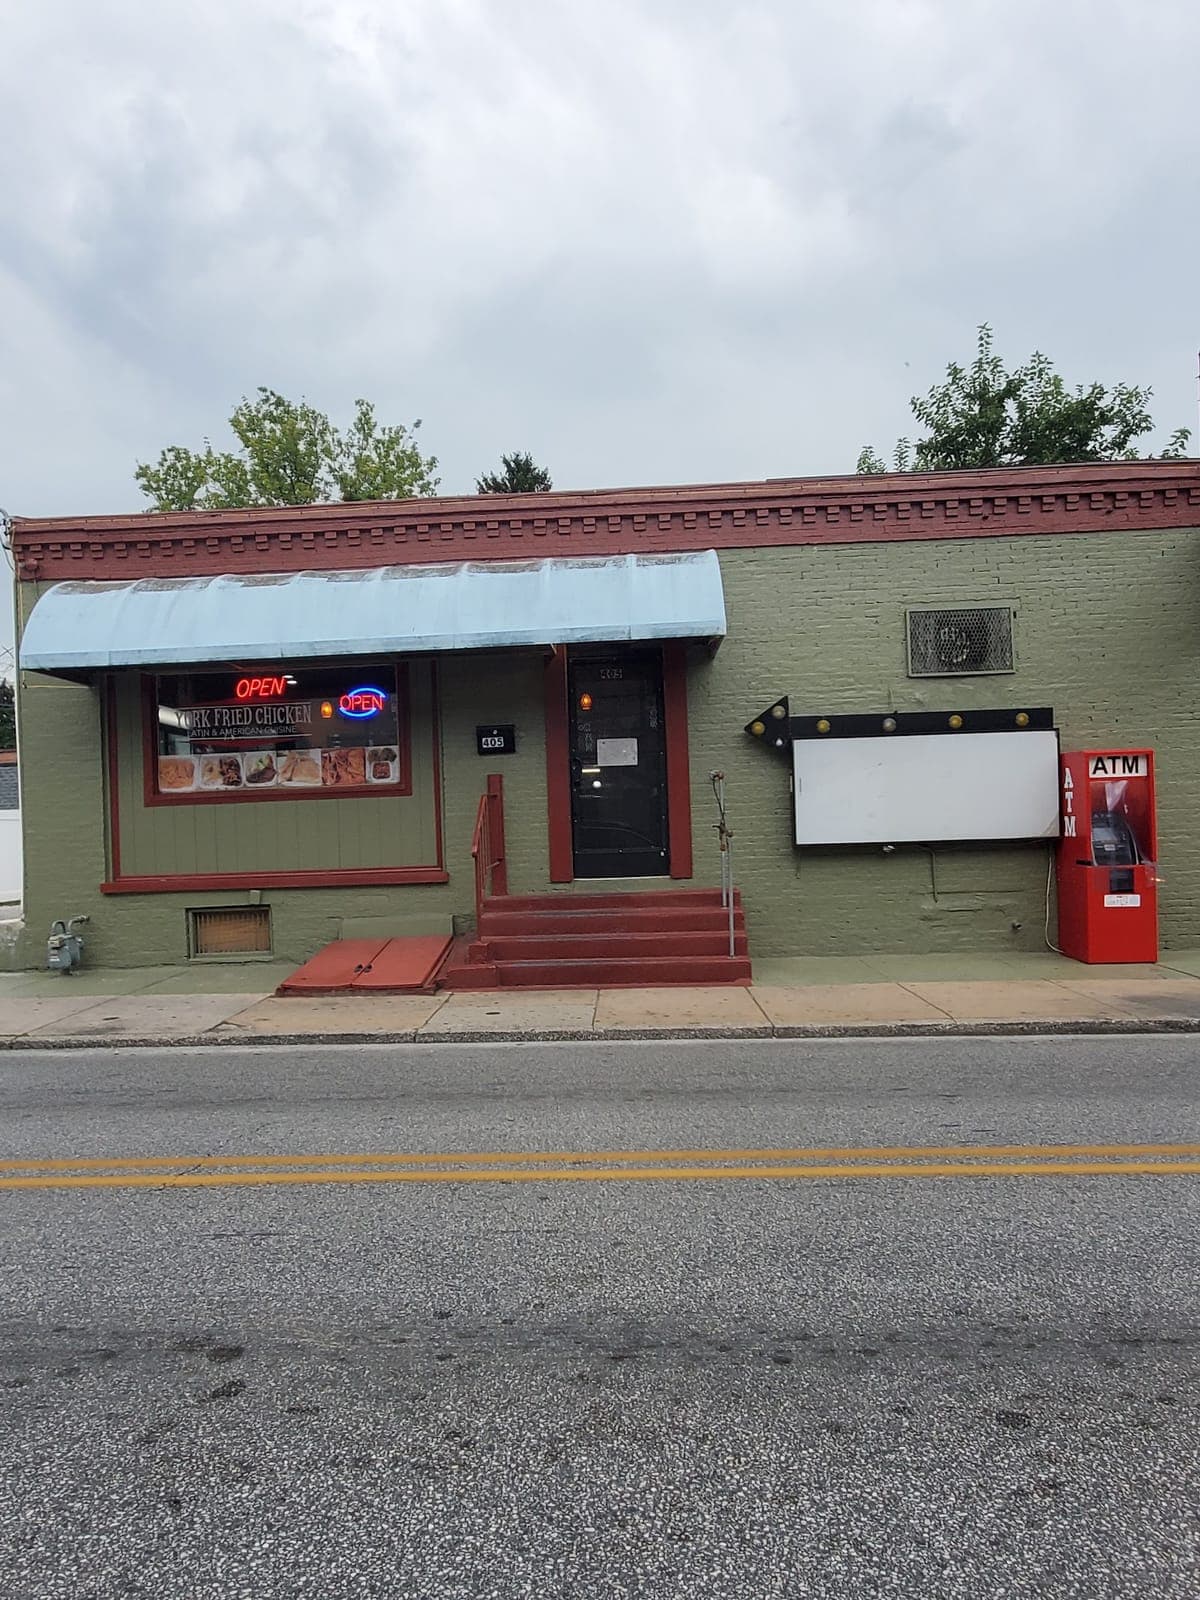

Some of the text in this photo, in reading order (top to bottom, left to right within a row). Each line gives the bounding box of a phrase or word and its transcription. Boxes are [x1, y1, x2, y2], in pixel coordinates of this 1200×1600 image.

[236, 677, 285, 698] OPEN
[339, 694, 383, 711] OPEN
[174, 705, 312, 728] YORK FRIED CHICKEN
[187, 728, 210, 738] ATIN
[211, 728, 218, 737] &
[219, 726, 263, 737] AMERICAN
[483, 737, 504, 748] 405
[1092, 755, 1139, 775] ATM
[1063, 767, 1077, 838] ATM
